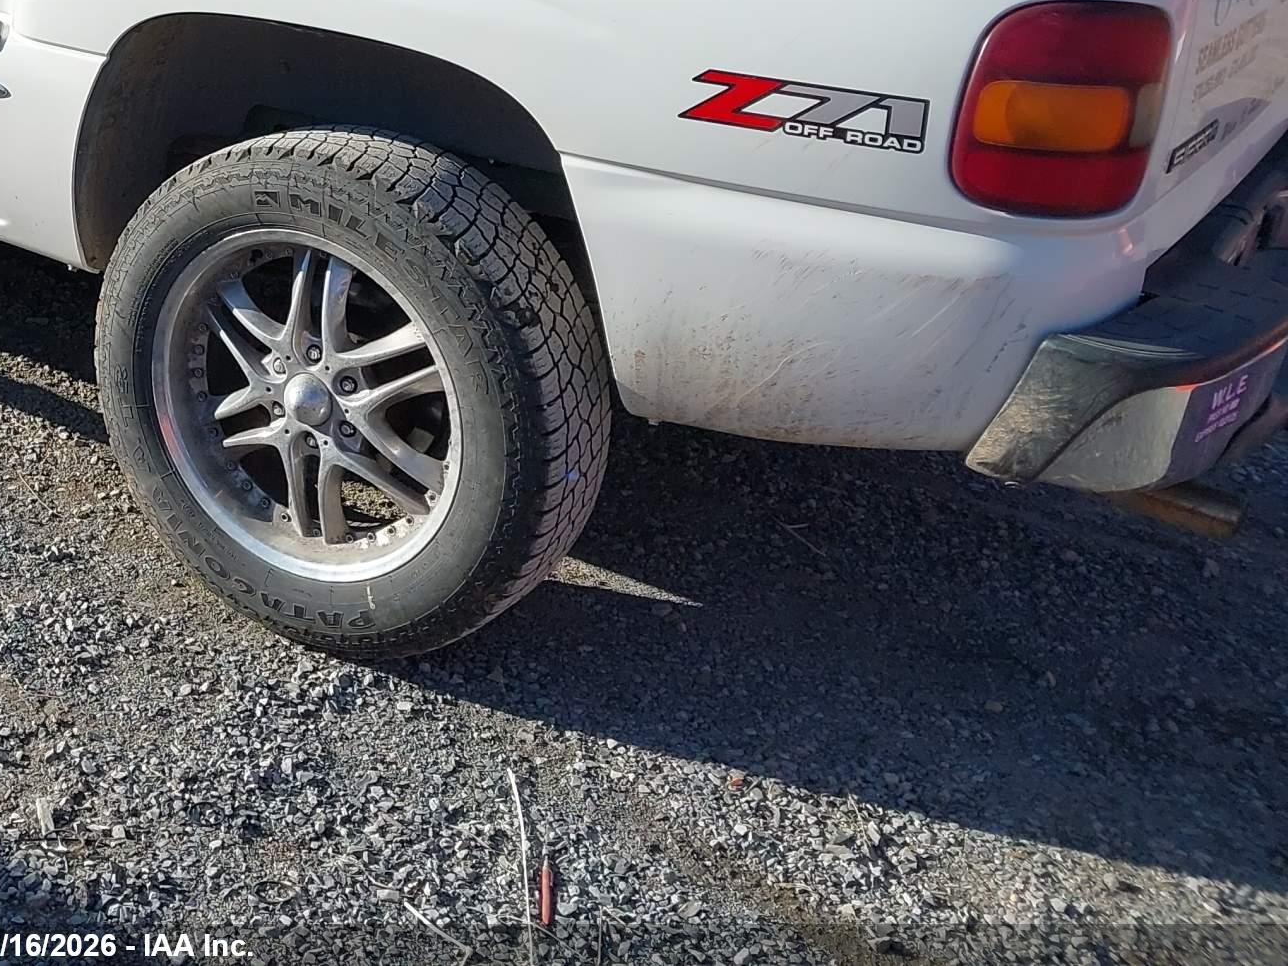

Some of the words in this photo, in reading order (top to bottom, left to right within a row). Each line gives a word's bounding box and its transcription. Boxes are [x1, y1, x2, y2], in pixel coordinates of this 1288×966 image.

[677, 68, 930, 133] Z71
[784, 121, 834, 140] OFF
[846, 131, 924, 154] ROAD
[288, 192, 490, 395] MILESTAR
[150, 484, 378, 630] PATAGONIA
